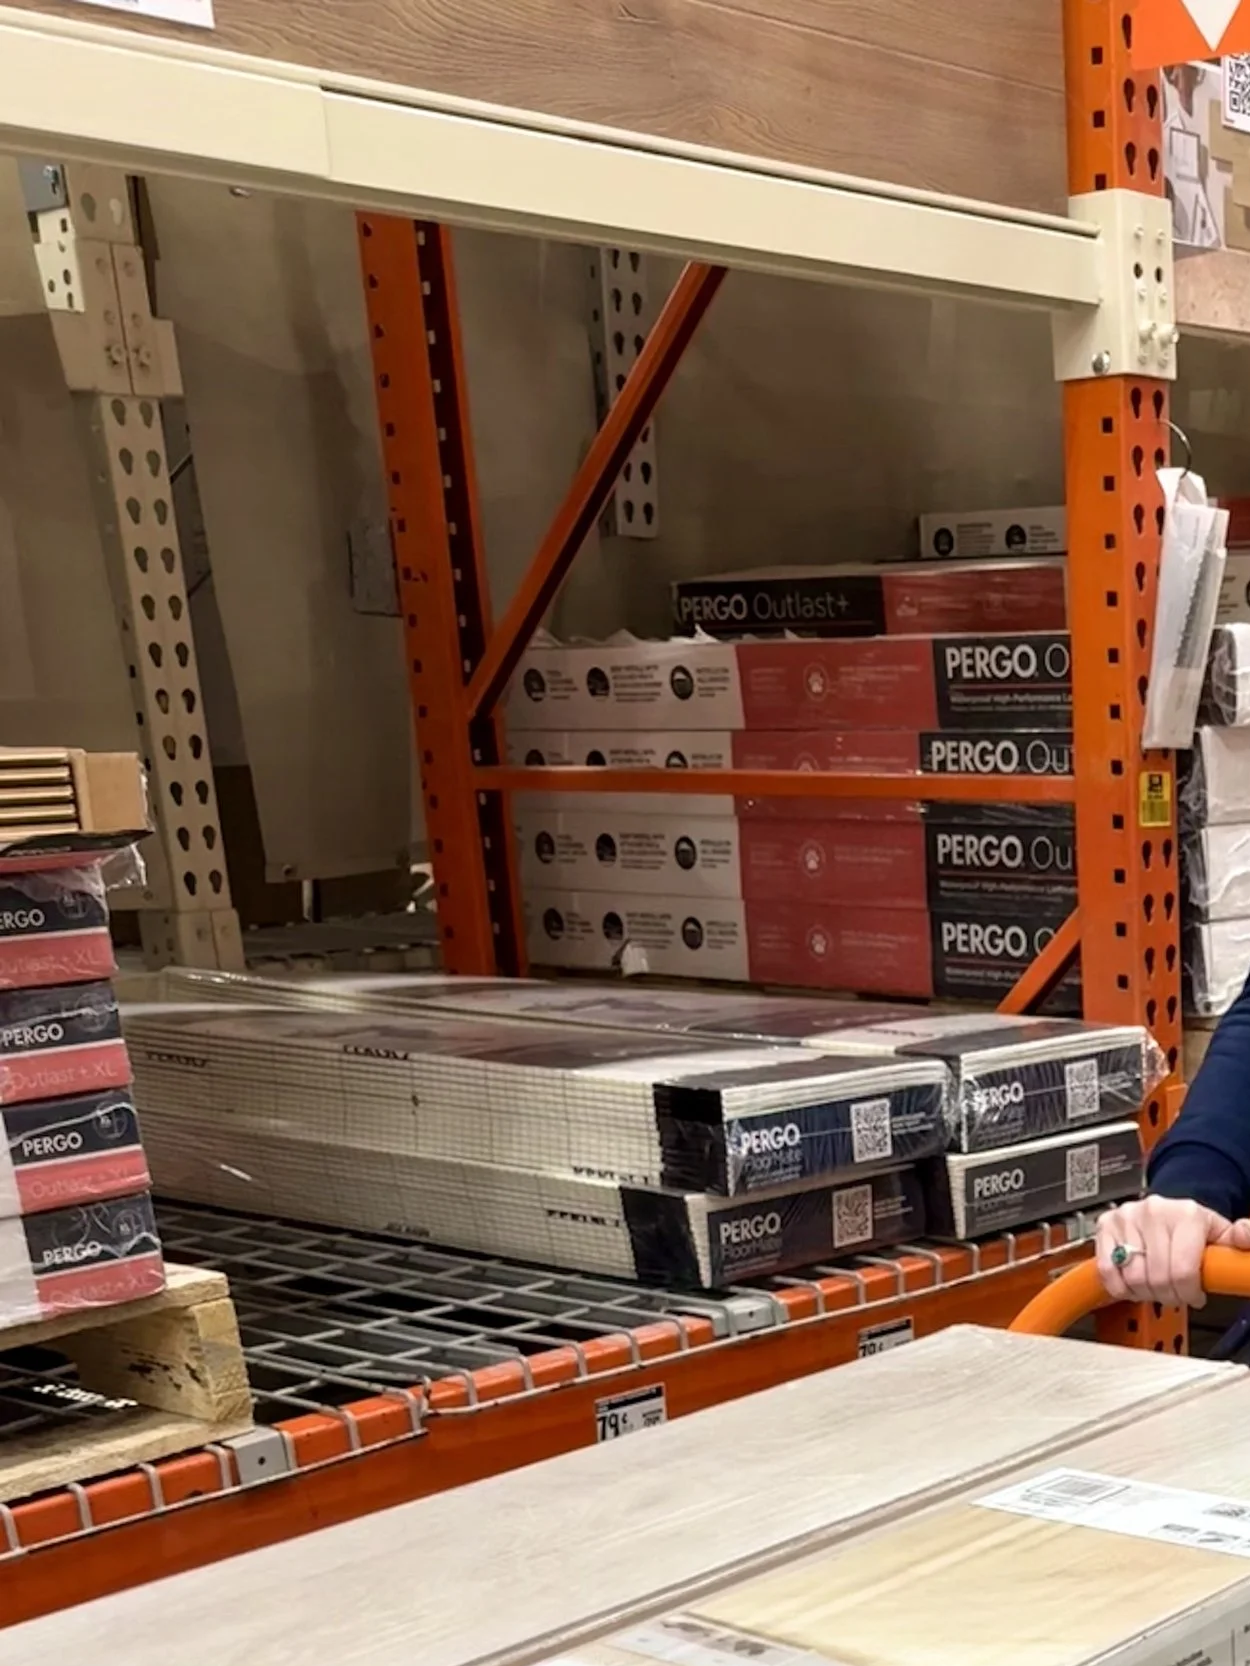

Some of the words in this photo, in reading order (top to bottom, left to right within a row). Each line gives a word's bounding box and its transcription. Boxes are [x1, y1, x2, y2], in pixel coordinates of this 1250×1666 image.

[681, 595, 749, 622] PERGO
[754, 590, 850, 621] Outlast+
[945, 644, 1038, 680] PERGO
[931, 740, 1020, 773] PERGO
[937, 833, 1025, 868] PERGO
[0, 908, 46, 929] ERGO
[75, 947, 101, 964] XL
[941, 922, 1028, 958] PERGO
[2, 1023, 64, 1047] PERGO
[12, 1064, 76, 1091] Outlast
[92, 1060, 119, 1080] XL
[973, 1081, 1025, 1113] PERGO
[22, 1131, 84, 1157] PERGO
[740, 1122, 801, 1154] PERGO
[973, 1168, 1025, 1199] PERGO
[719, 1211, 782, 1246] PERGO
[42, 1240, 101, 1267] PERGO
